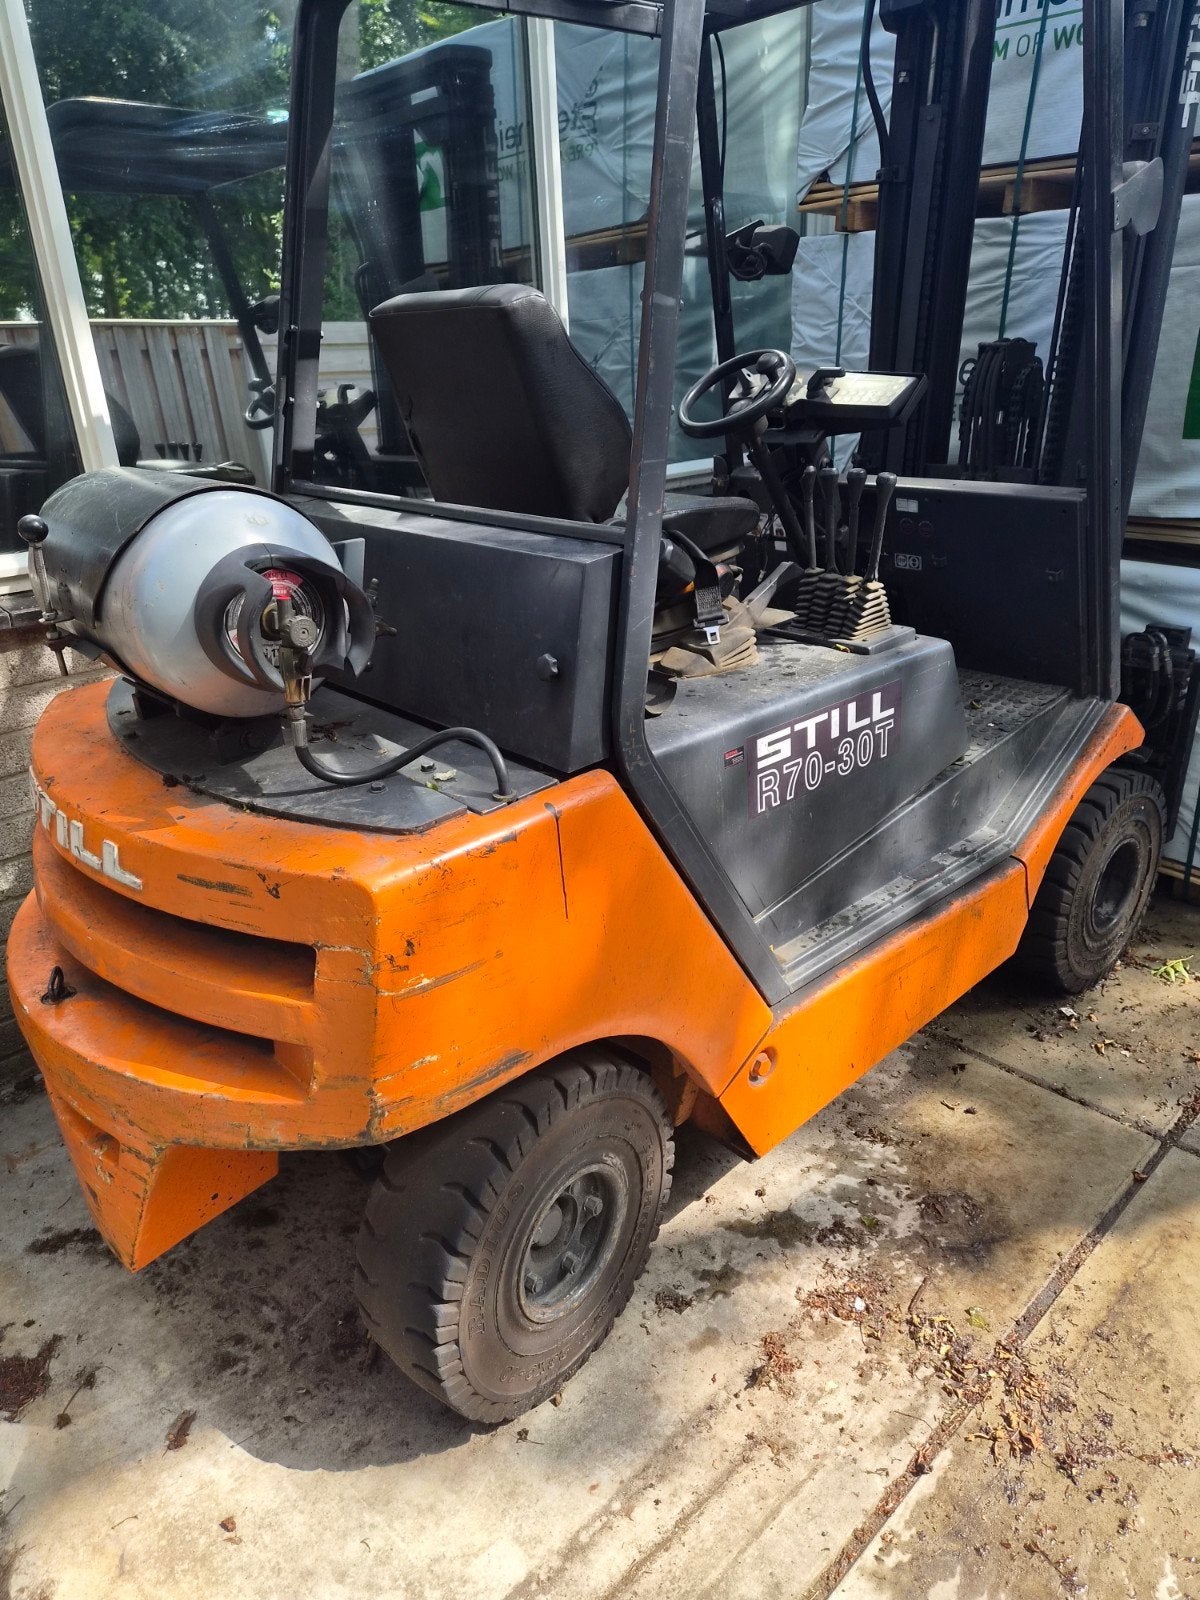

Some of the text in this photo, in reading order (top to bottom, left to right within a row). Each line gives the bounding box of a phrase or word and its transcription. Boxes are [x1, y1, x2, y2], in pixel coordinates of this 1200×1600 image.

[756, 719, 894, 813] R70-30T
[757, 691, 895, 770] STILL
[30, 766, 142, 890] TILL
[467, 1182, 525, 1337] RADIUS
